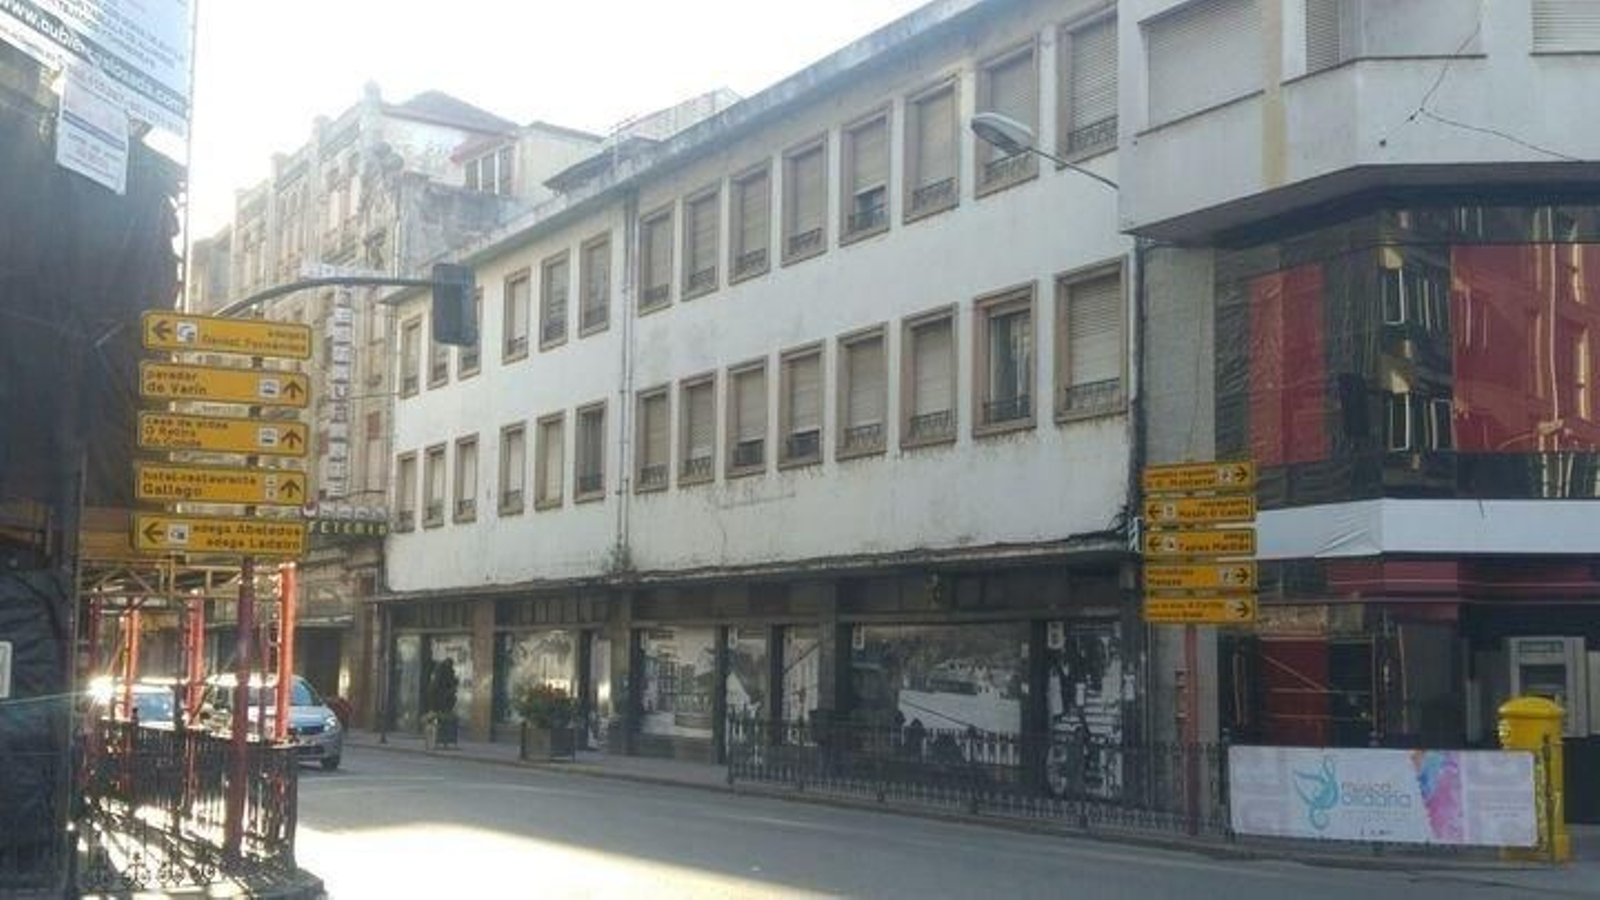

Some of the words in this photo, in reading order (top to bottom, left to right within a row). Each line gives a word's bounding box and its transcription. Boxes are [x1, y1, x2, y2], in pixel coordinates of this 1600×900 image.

[146, 370, 197, 384] parador
[146, 381, 166, 393] de
[143, 483, 203, 499] Gallego
